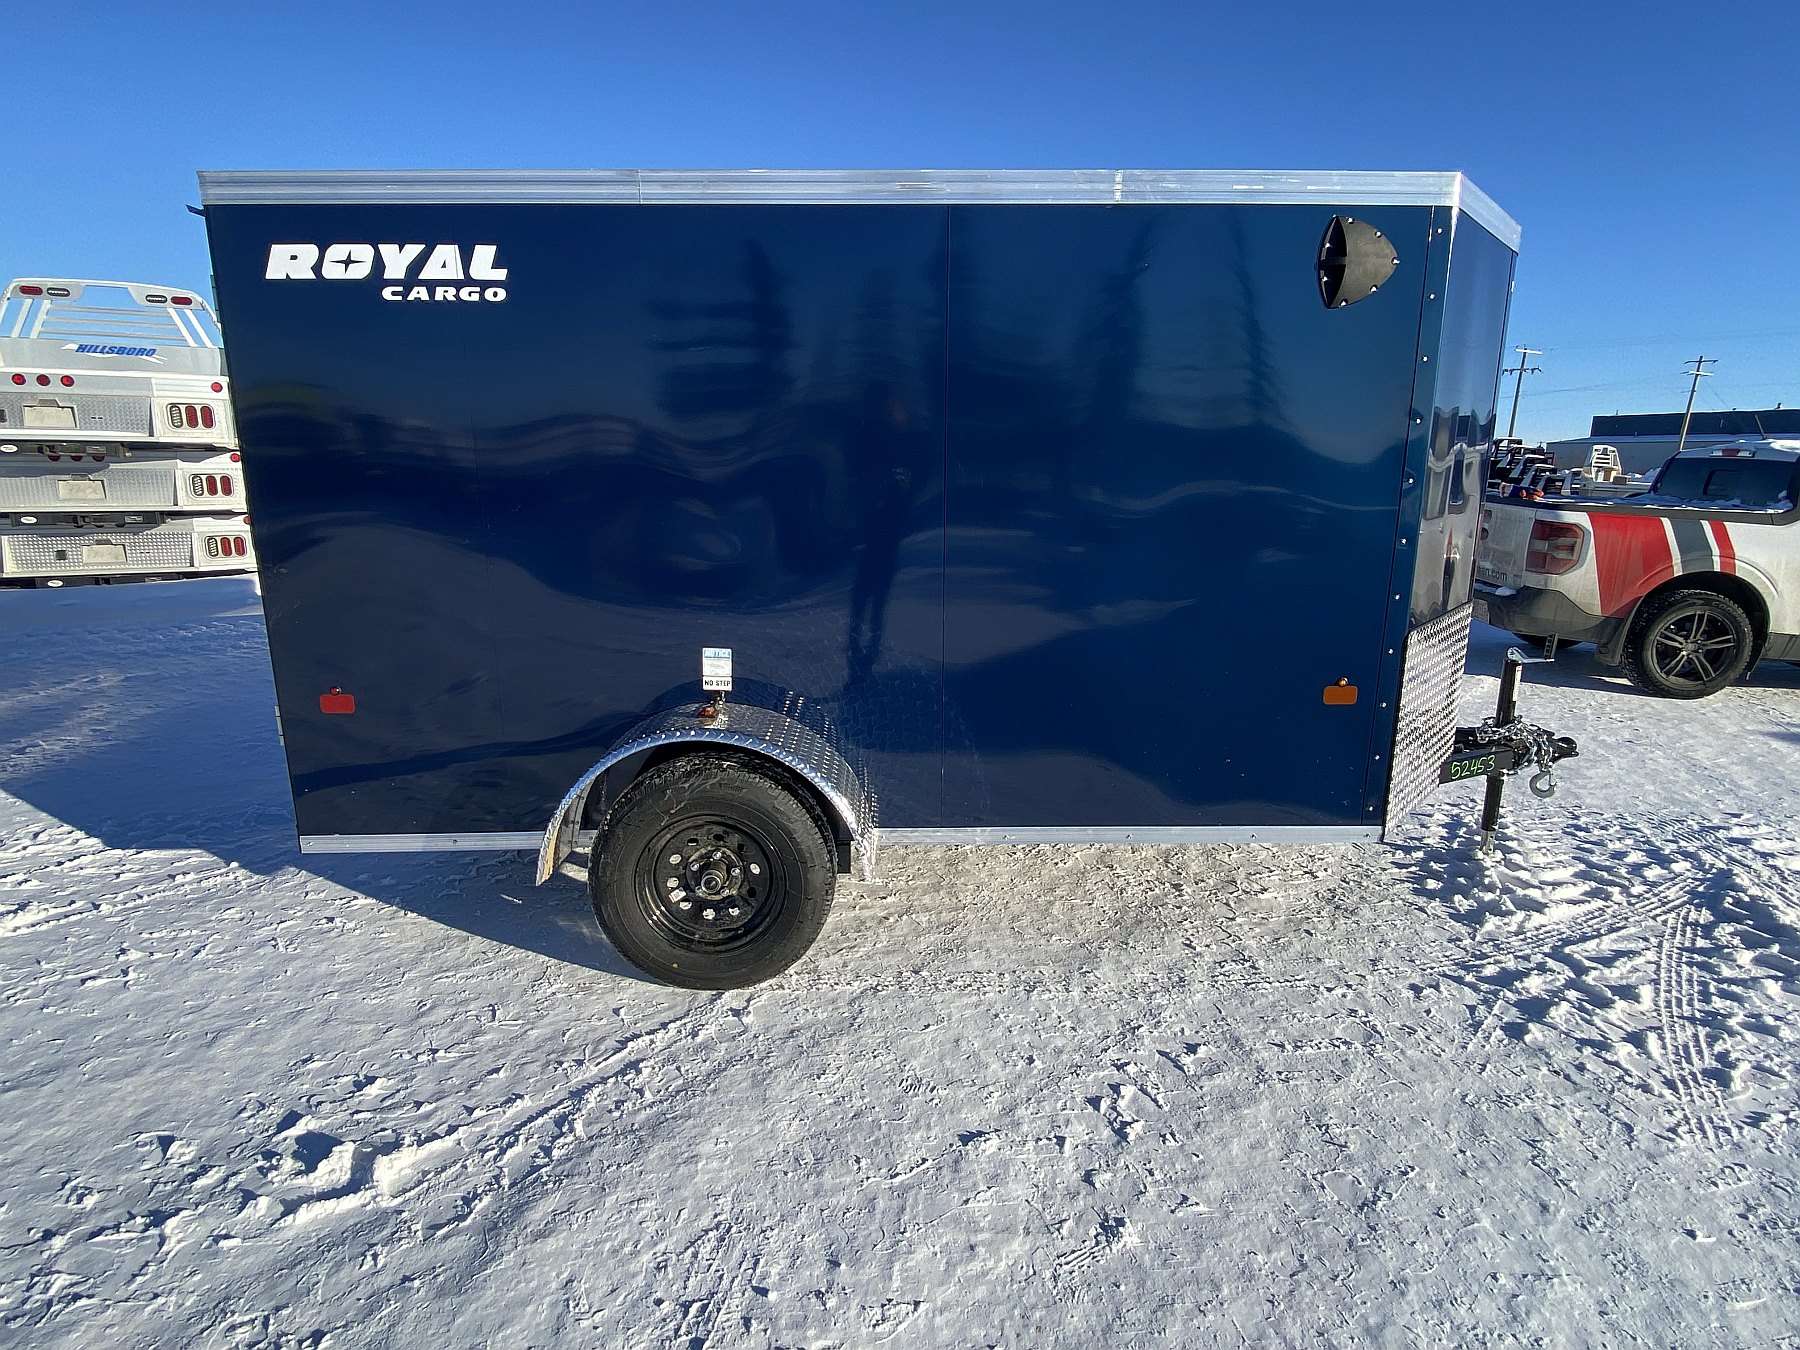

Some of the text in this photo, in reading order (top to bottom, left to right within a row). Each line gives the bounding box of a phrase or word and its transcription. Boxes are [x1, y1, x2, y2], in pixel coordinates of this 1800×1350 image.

[265, 243, 508, 281] ROYAL
[381, 286, 507, 302] CARGO
[75, 343, 157, 357] HILLSBORO
[704, 679, 714, 687] NO
[1451, 754, 1496, 780] 52453
